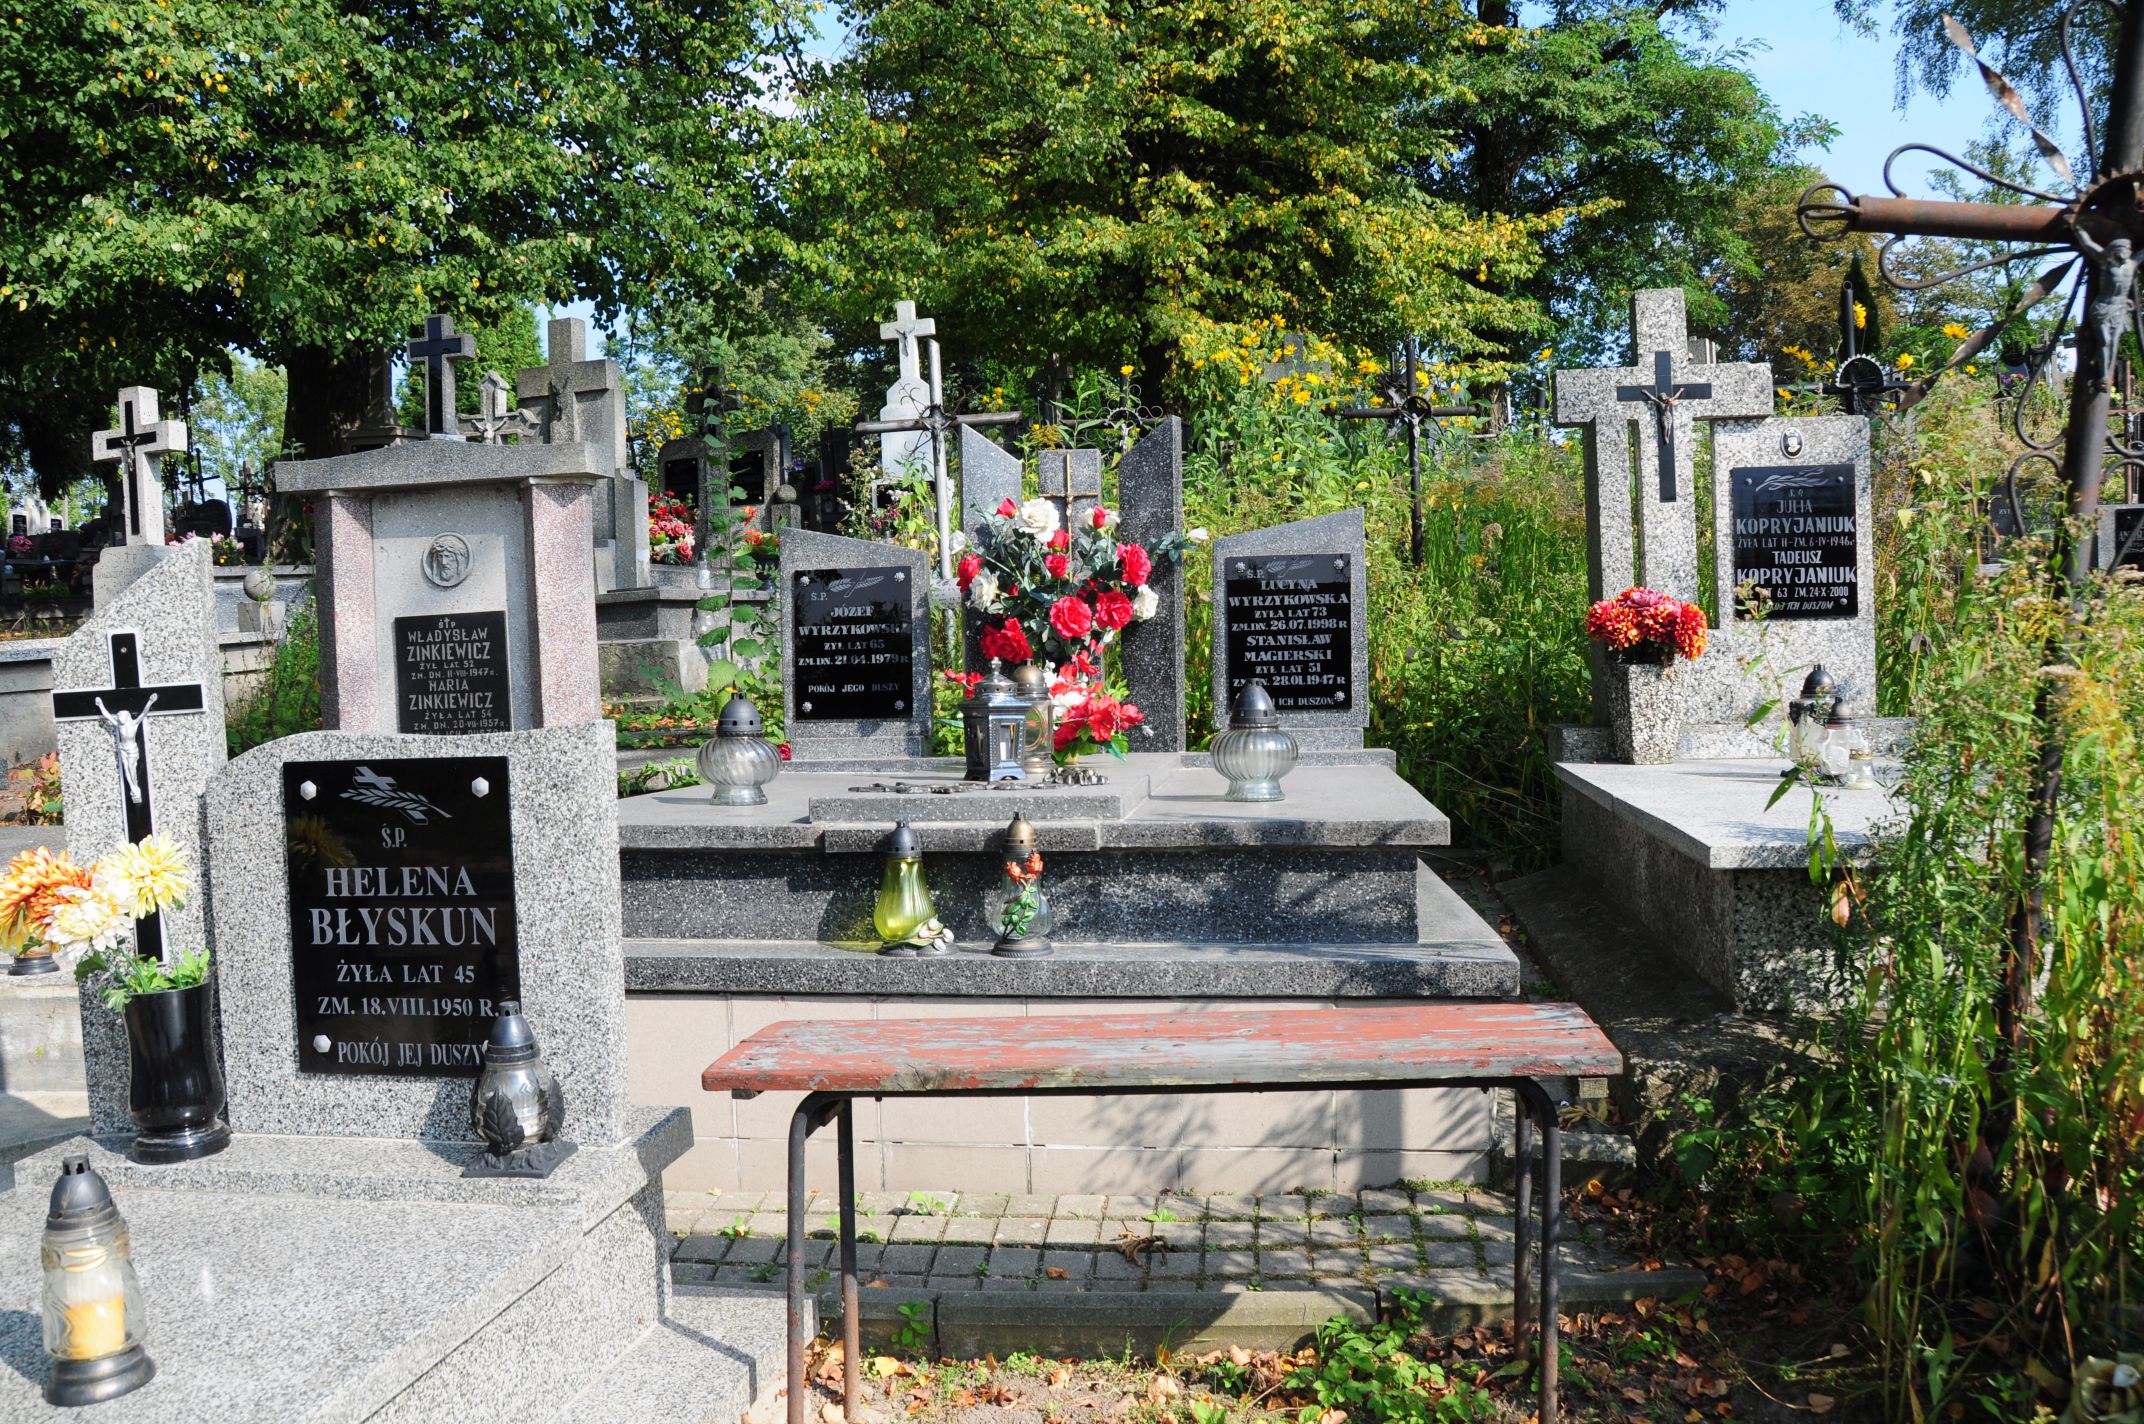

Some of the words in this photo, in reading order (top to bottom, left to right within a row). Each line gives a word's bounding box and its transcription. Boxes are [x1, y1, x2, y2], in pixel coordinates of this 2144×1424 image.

[1776, 499, 1812, 513] JULIA
[1736, 516, 1855, 535] KOPRYJANIUK
[1772, 550, 1822, 564] TADEUSZ
[1737, 567, 1856, 584] KOPRYJANIUK
[1260, 579, 1318, 591] LUCYNA
[1228, 593, 1350, 607] WYRZYKOWSKA
[1777, 588, 1788, 598] 63
[830, 603, 875, 617] JÓZEF
[1288, 609, 1310, 617] LAT
[1312, 606, 1328, 617] 73
[1270, 619, 1337, 631] 26.07.1998
[408, 628, 488, 642] WŁADYSŁAW
[1247, 634, 1332, 646] STANISŁAW
[869, 639, 885, 648] 65
[406, 642, 491, 662] ZINKIEWICZ
[1244, 650, 1332, 661] MAGIERSKI
[463, 660, 474, 668] 52
[1281, 664, 1303, 673] LAT
[1309, 663, 1321, 672] 51
[429, 678, 469, 692] MARIA
[808, 683, 835, 693] POKÓJ
[842, 684, 864, 692] JEGO
[409, 692, 493, 710] ZINKIEWICZ
[1279, 697, 1293, 706] ICH
[424, 711, 453, 720] ŻYŁA
[458, 710, 476, 719] LAT
[482, 709, 492, 718] 54
[381, 823, 408, 849] Ś.P.
[324, 865, 478, 898] HELENA
[309, 906, 497, 947] BŁYSKUN
[336, 959, 393, 984] ŻYŁA
[403, 965, 444, 983] LAT
[454, 965, 475, 984] 45
[318, 996, 355, 1015] ZM.
[361, 996, 473, 1017] 18.VIII.1950
[338, 1036, 390, 1065] POKÓJ
[397, 1042, 423, 1067] JEJ
[431, 1043, 483, 1067] DUSZY
